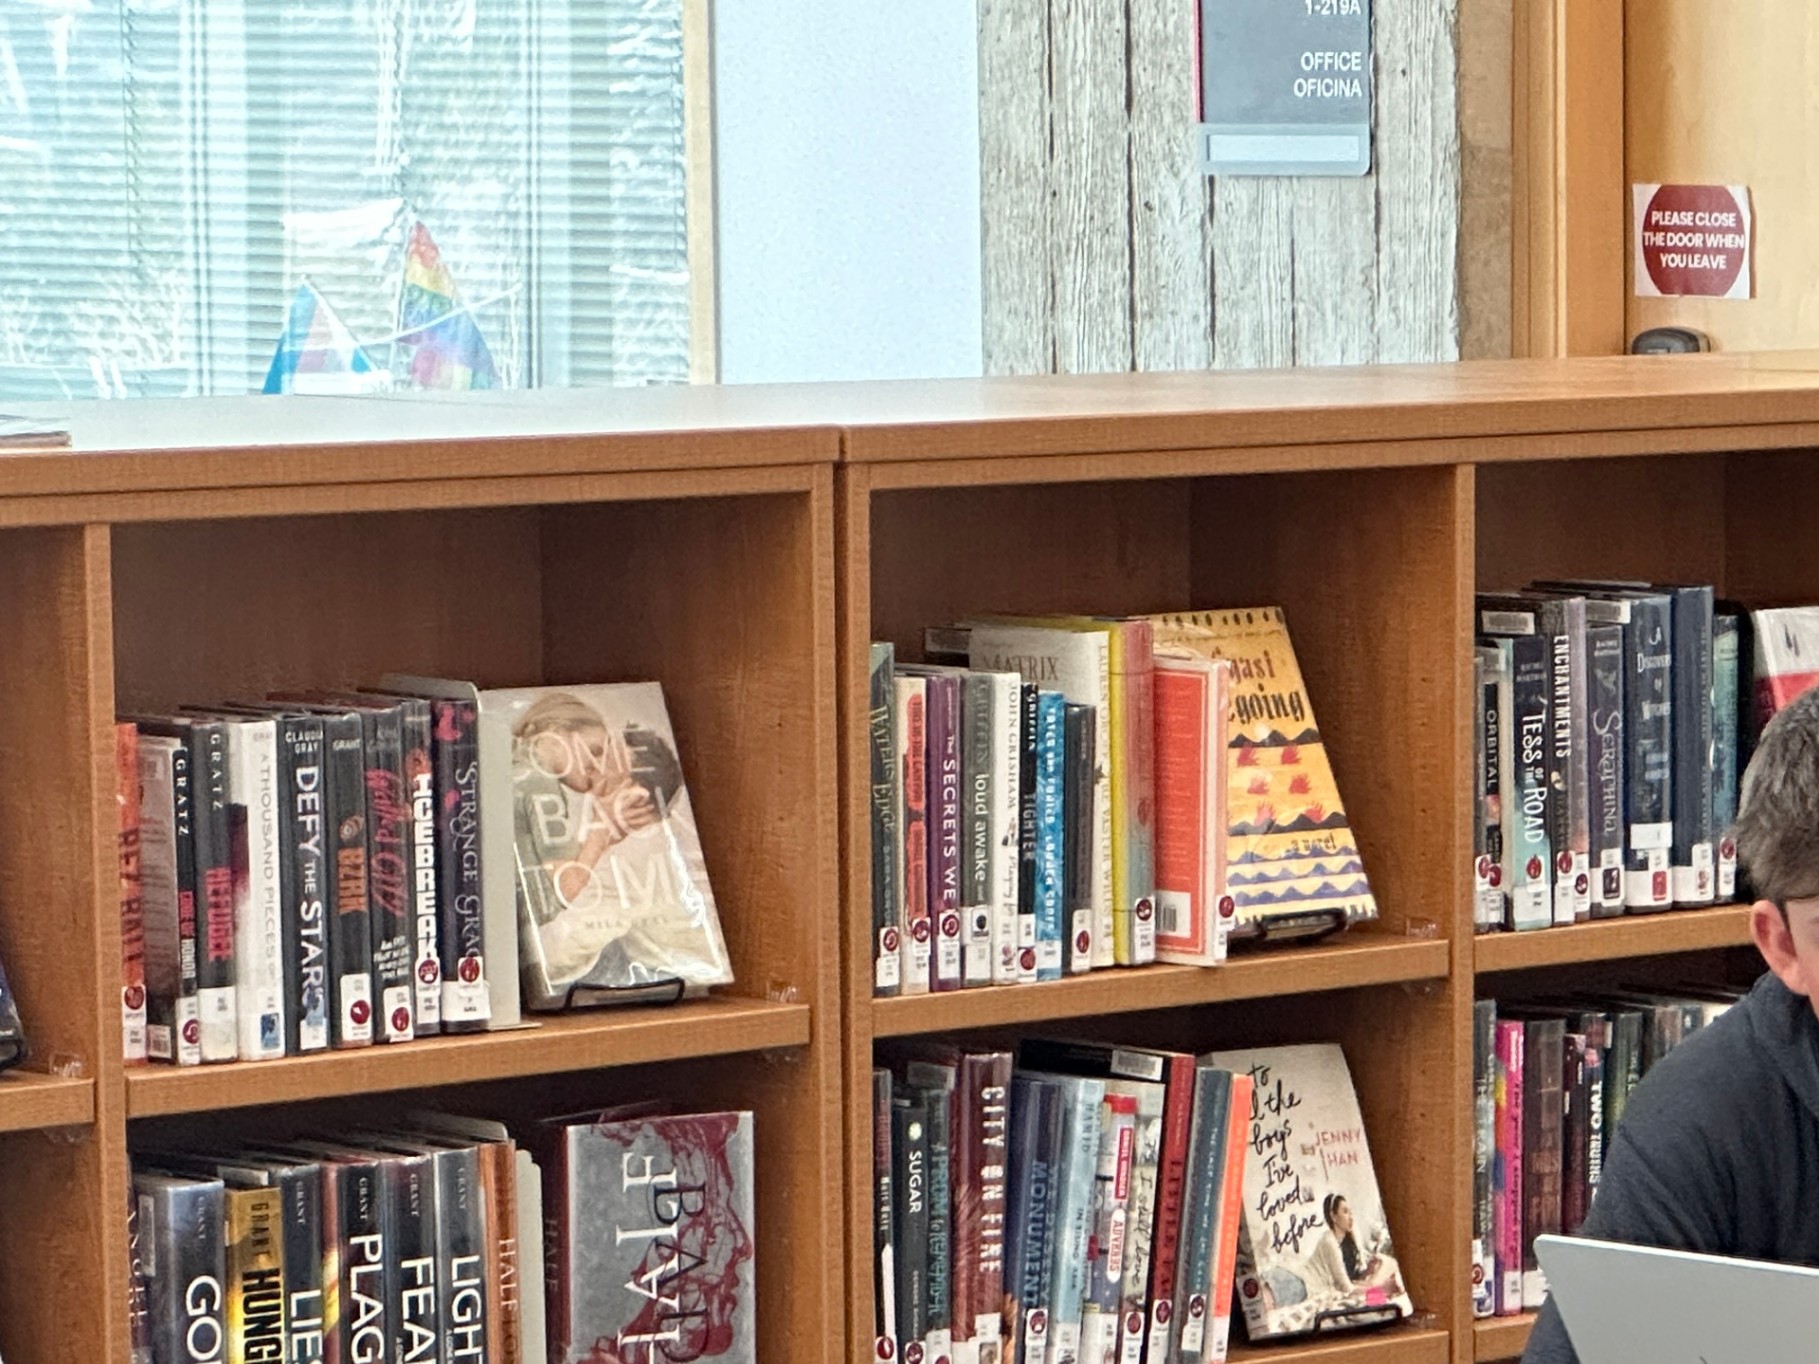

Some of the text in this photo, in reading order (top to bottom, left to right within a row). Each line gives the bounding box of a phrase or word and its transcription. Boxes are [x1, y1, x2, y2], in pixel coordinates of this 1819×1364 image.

[1301, 52, 1362, 71] OFFICE
[1293, 78, 1363, 97] OFICINA
[1643, 231, 1745, 249] THE DOOR WHEN
[1651, 210, 1737, 227] PLEASE CLOSE
[1660, 252, 1727, 269] YOU LEAVE
[981, 654, 1059, 680] MATRIX
[1007, 684, 1018, 727] JOHN
[1554, 635, 1571, 758] ENCHANTMENTS
[294, 741, 319, 754] GRAY
[1486, 709, 1497, 787] ORBITAL
[1008, 733, 1019, 808] GRISHAM
[1023, 693, 1037, 861] GRIFFIN TIGHTER
[1522, 711, 1547, 843] TESS OF THE ROAD
[174, 758, 189, 837] GRATZ
[296, 766, 322, 858] DEFY
[943, 760, 957, 857] SECRETS
[974, 774, 989, 815] loud
[454, 761, 480, 882] STRANGE
[207, 733, 234, 962] GRATZ REFUGEE
[262, 766, 277, 959] THOUSAND PIECES
[974, 822, 988, 881] awake
[304, 861, 317, 892] THE
[943, 866, 957, 901] WE
[181, 938, 197, 979] HONOR
[1264, 1079, 1302, 1117] the
[1590, 1080, 1603, 1130] TWO
[1251, 1119, 1292, 1158] boys
[1315, 1128, 1361, 1150] JENNY
[908, 1151, 922, 1213] SUGAR
[979, 1086, 1005, 1274] CITY ON FIRE
[1262, 1152, 1359, 1188] I've HAN
[359, 1177, 370, 1221] GRANT
[410, 1173, 420, 1217] GRANT
[1257, 1175, 1302, 1221] loved
[250, 1202, 271, 1257] GRANT
[1271, 1213, 1324, 1254] before
[497, 1239, 518, 1311] HALF
[653, 1181, 709, 1364] BAD
[1132, 1245, 1150, 1287] love
